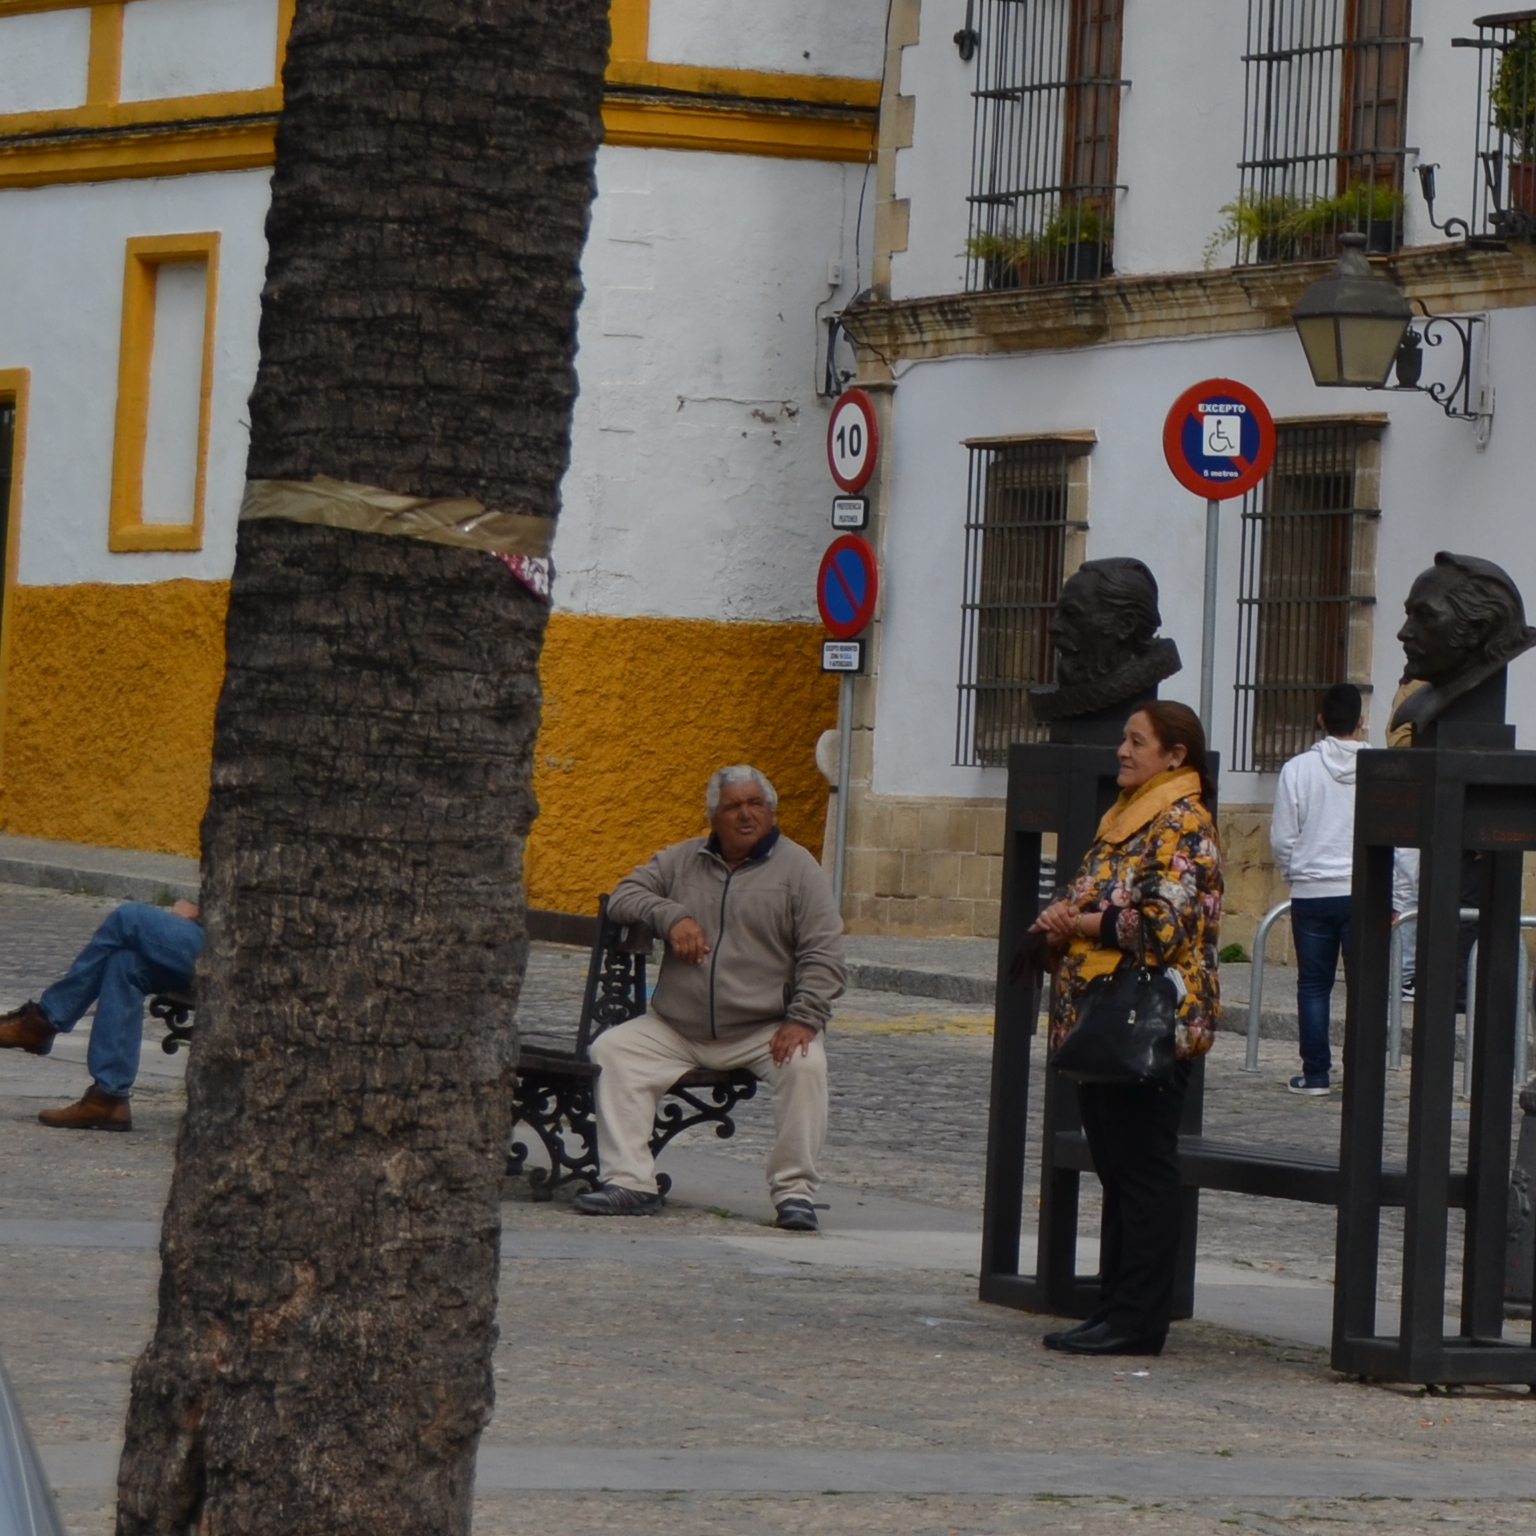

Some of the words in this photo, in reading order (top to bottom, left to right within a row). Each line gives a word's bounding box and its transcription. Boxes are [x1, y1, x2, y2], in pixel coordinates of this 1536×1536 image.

[1198, 403, 1246, 414] EXCEPTO
[836, 423, 862, 459] 10
[1211, 470, 1239, 478] metros
